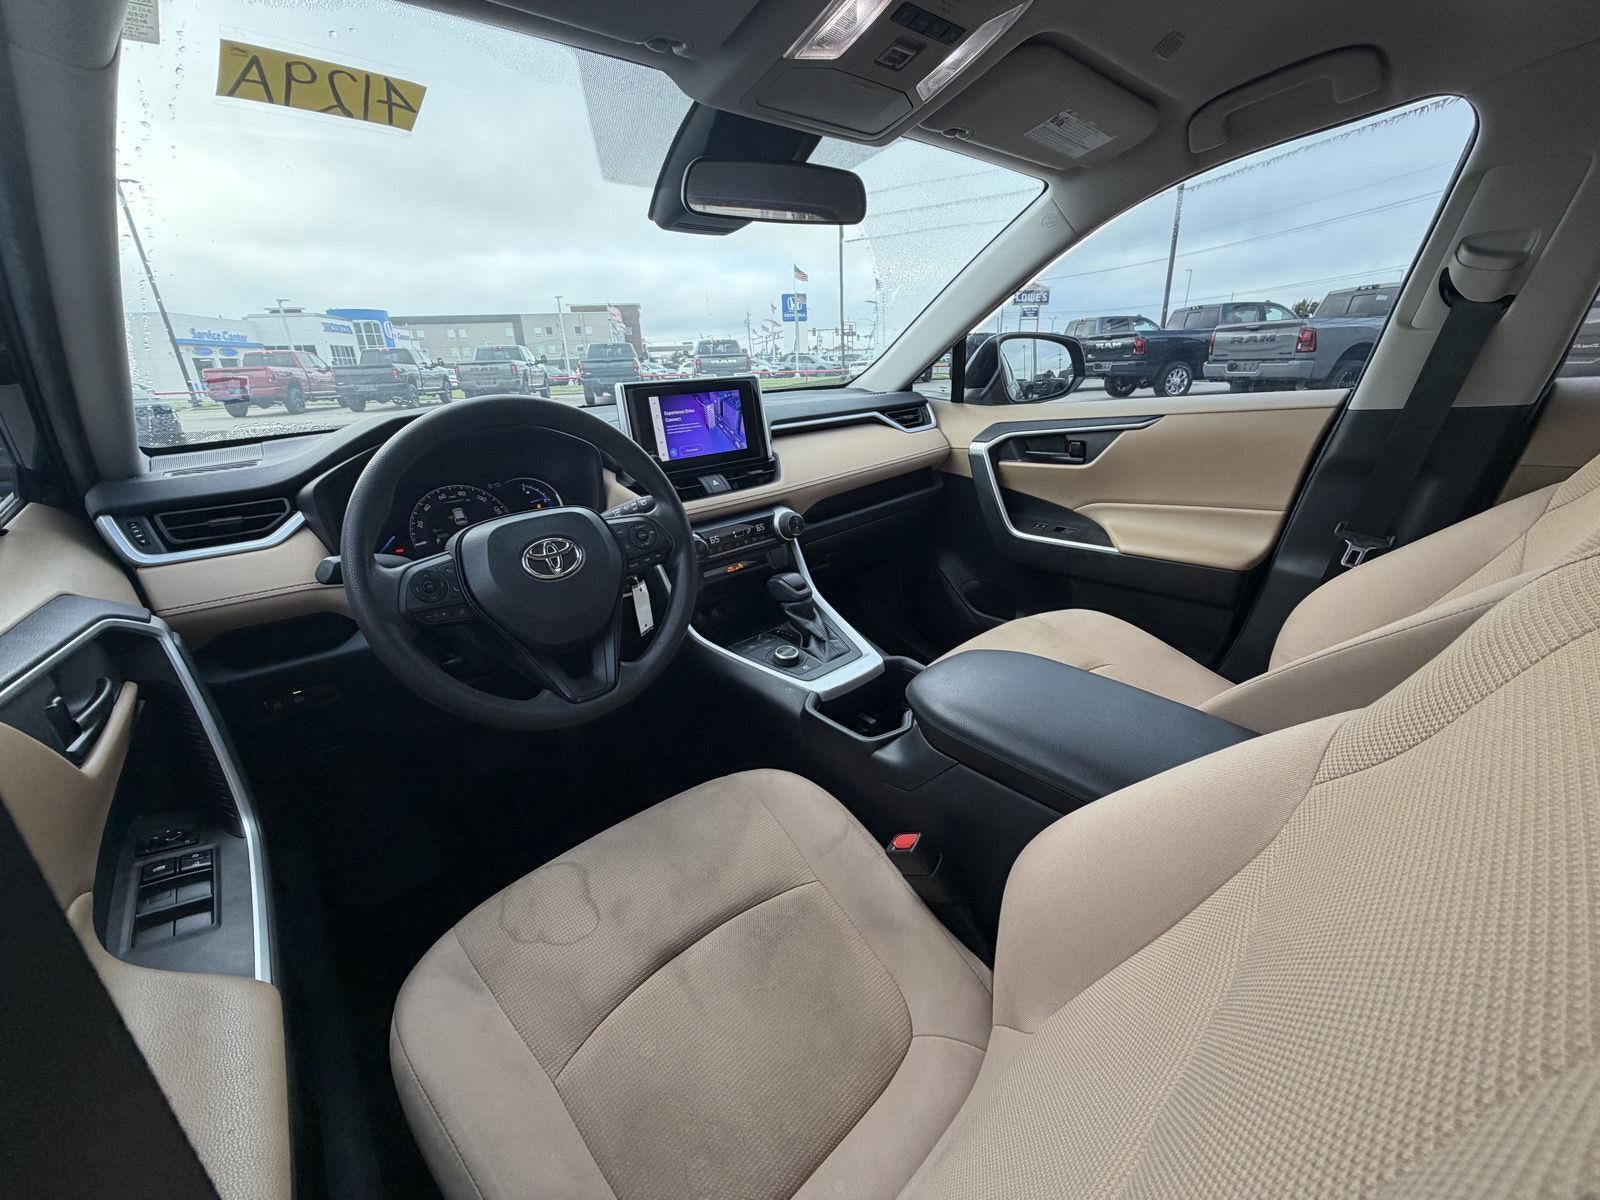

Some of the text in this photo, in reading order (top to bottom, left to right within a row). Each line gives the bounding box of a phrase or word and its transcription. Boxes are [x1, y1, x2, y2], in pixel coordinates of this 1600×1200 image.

[190, 327, 248, 341] Service Center
[1230, 334, 1276, 345] RAM
[1095, 342, 1122, 350] RAM
